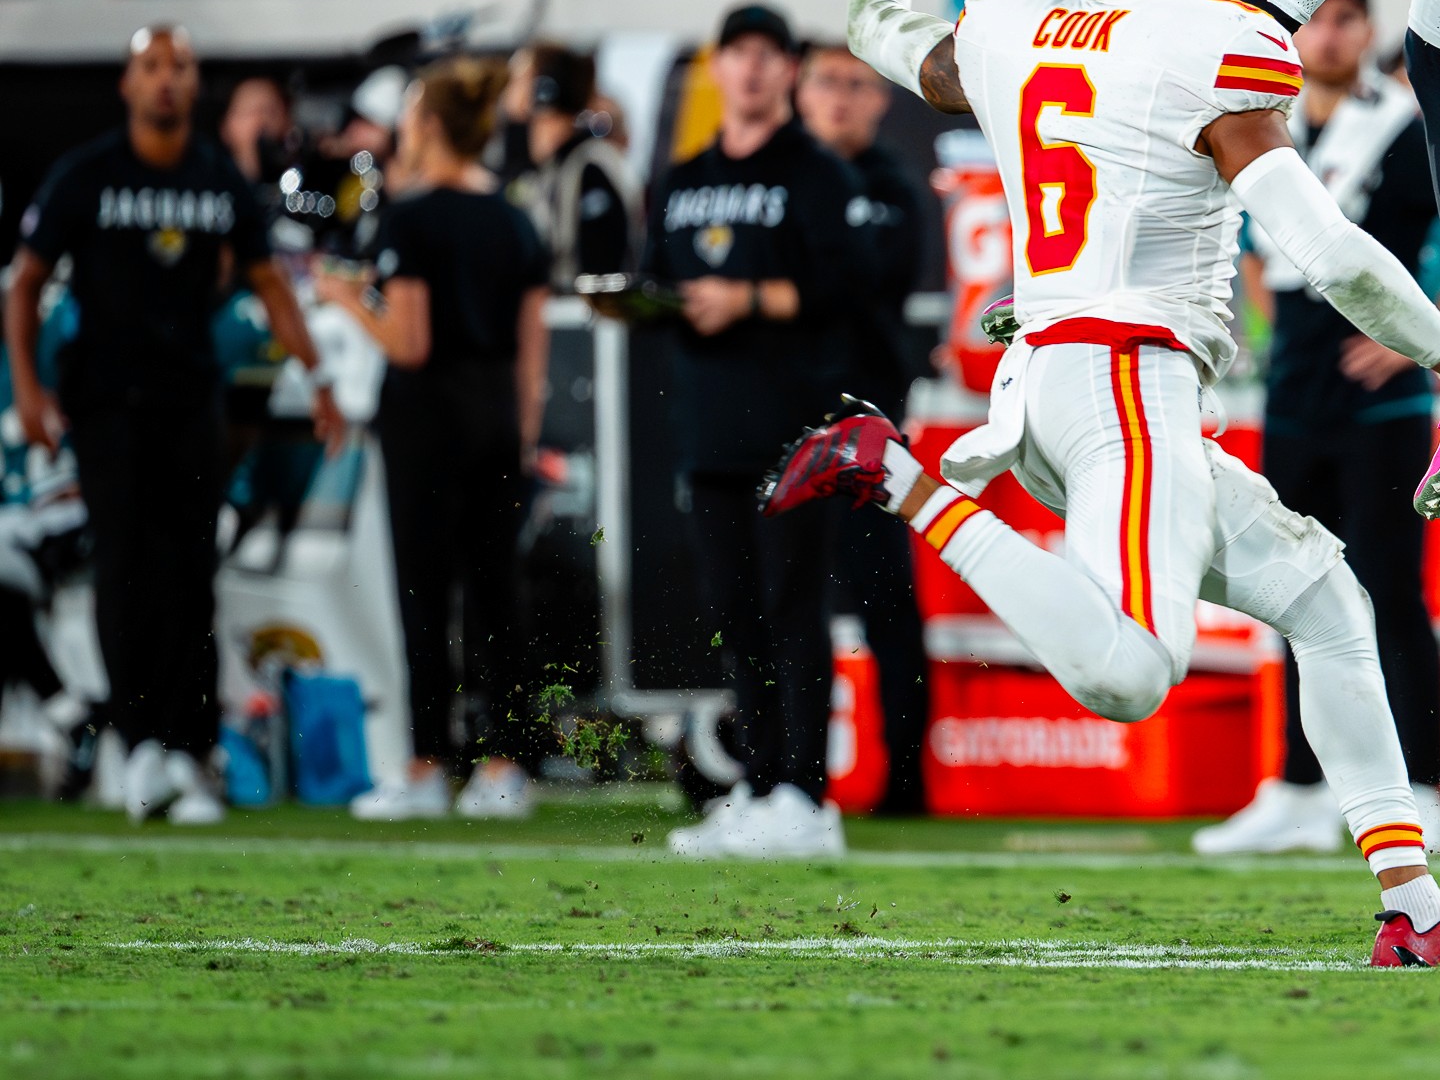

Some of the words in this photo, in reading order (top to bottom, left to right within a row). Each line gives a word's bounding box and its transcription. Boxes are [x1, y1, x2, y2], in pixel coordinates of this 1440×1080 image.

[1032, 7, 1132, 52] COOK
[1018, 62, 1098, 277] 6
[97, 186, 236, 234] JAGUARS
[663, 182, 789, 232] JAGUARS
